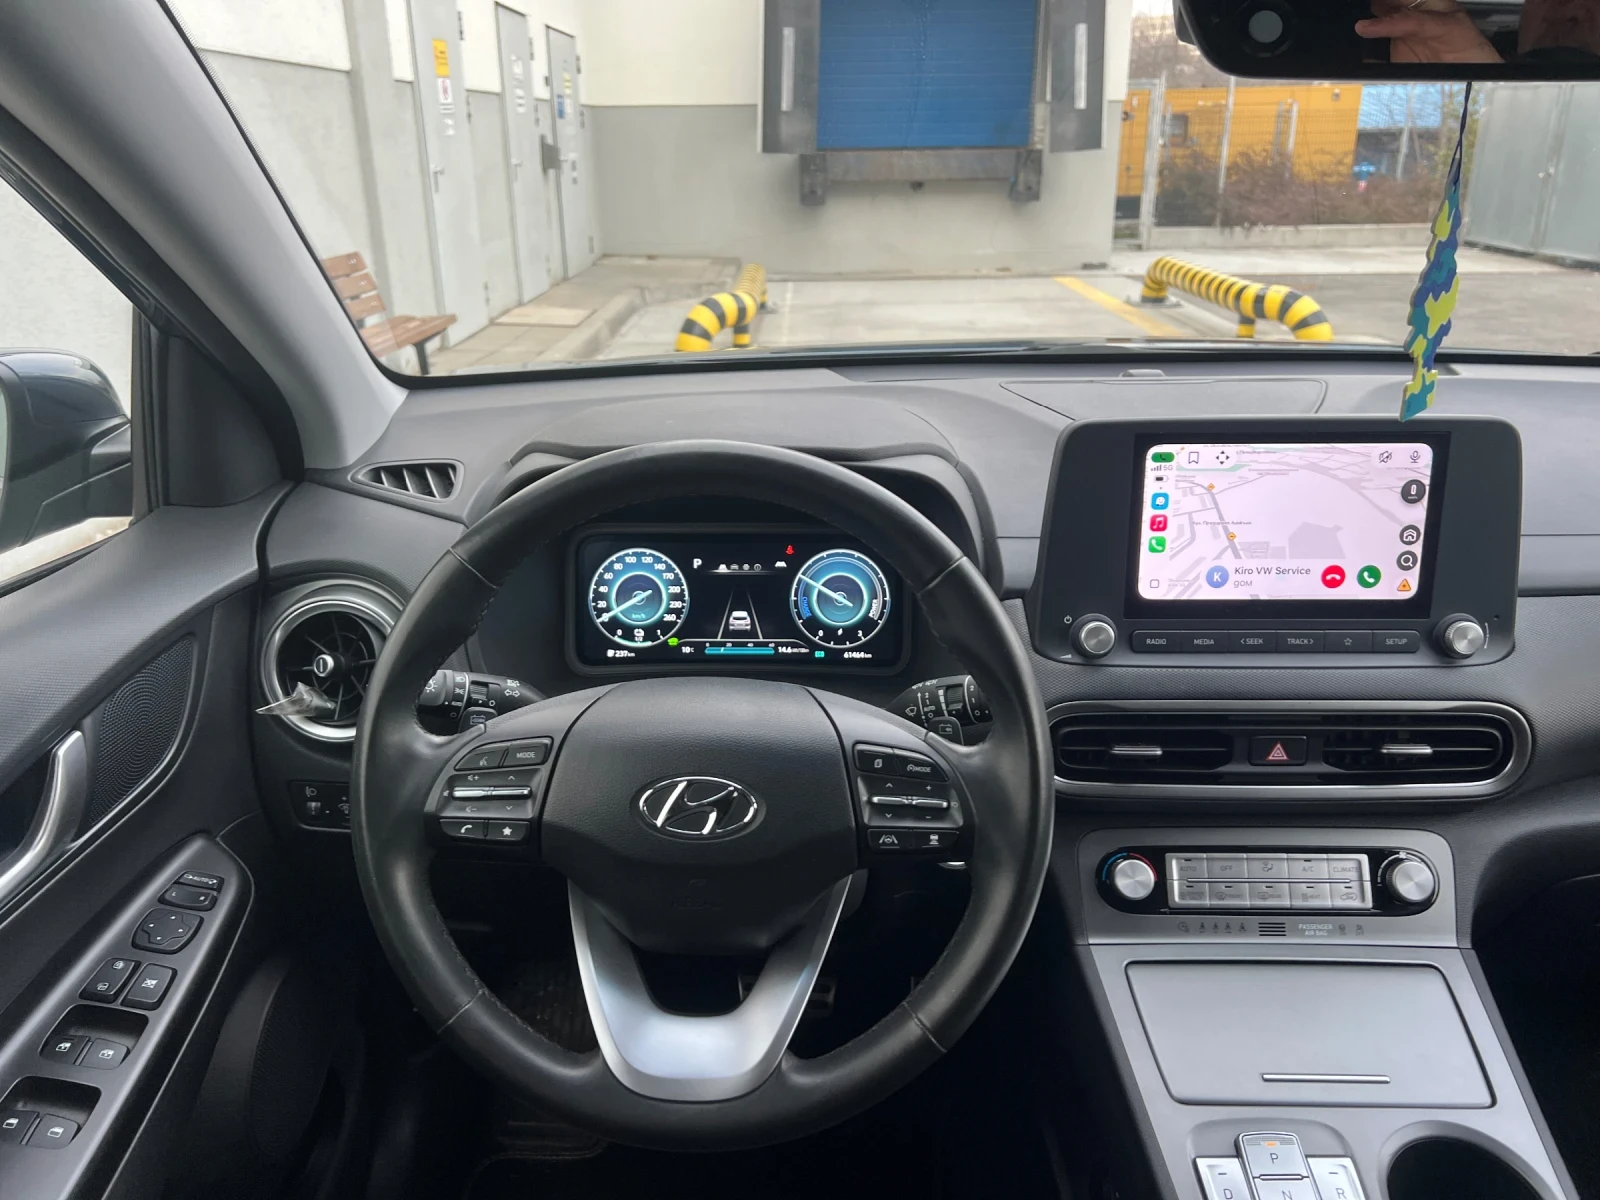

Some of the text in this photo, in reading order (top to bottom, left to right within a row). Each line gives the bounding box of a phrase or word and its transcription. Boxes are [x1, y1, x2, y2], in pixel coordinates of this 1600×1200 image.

[1410, 484, 1417, 495] 0
[693, 558, 702, 568] P
[1276, 566, 1311, 574] Service
[1213, 572, 1222, 582] K
[868, 599, 878, 618] POWER
[1270, 1152, 1278, 1164] P
[1223, 1188, 1234, 1200] D
[1282, 1190, 1293, 1200] N
[1336, 1188, 1348, 1200] R
